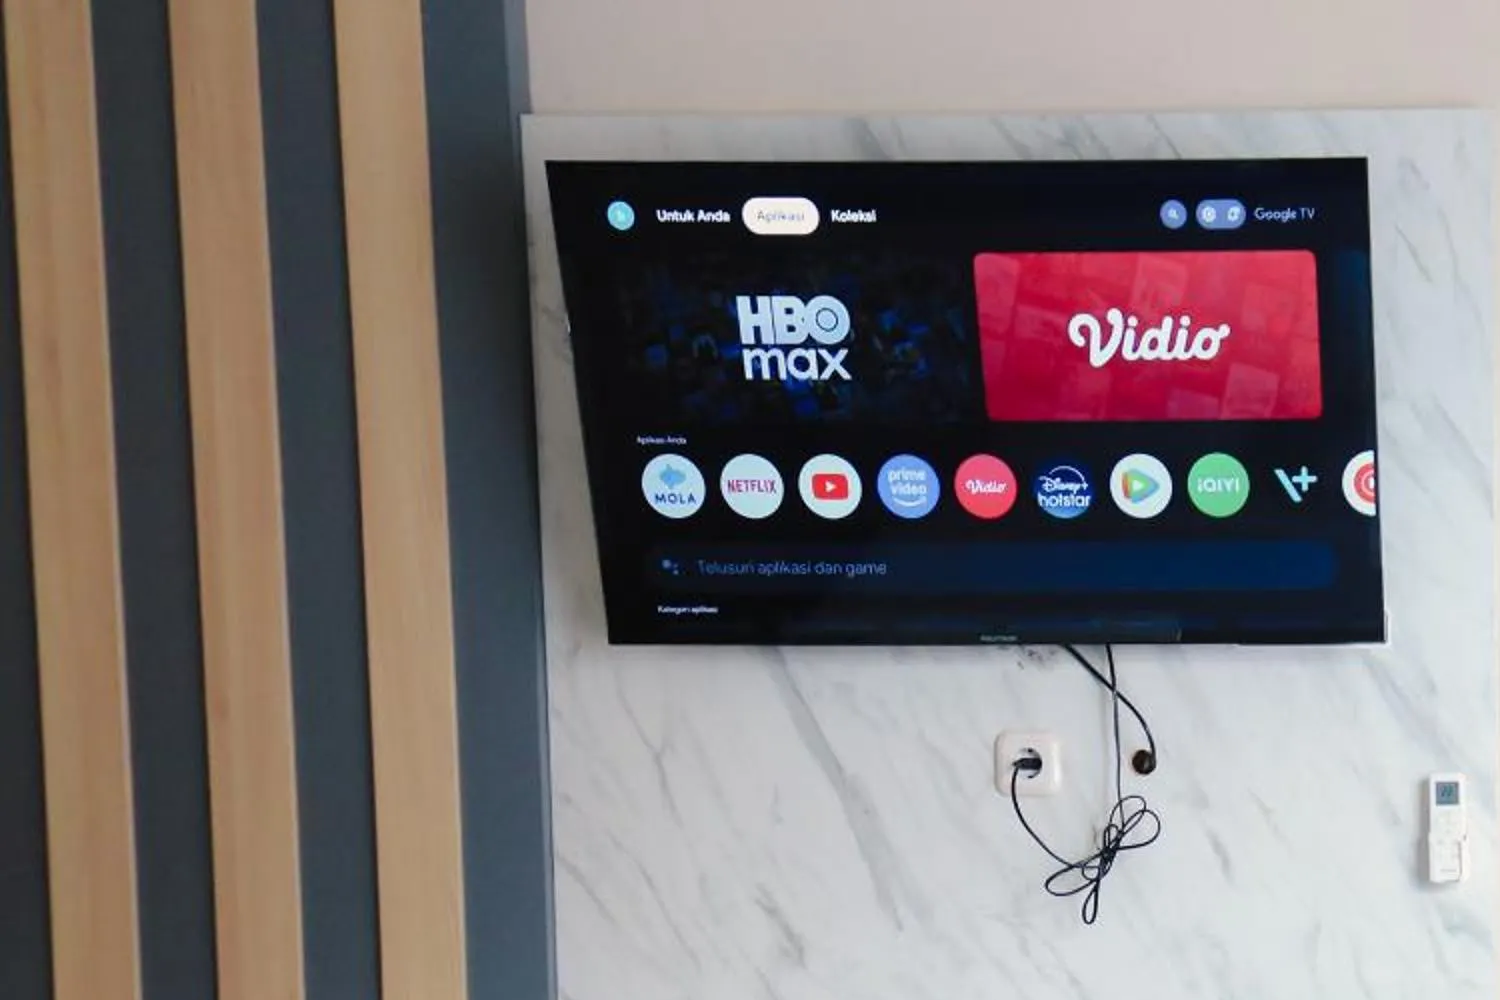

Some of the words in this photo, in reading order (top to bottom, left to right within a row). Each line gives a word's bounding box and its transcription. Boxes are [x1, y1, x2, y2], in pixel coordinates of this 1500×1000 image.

[656, 208, 694, 222] Untuk
[697, 208, 731, 222] Anda
[756, 209, 805, 224] Aplikasi
[831, 209, 877, 222] Koleksi
[1254, 206, 1298, 221] Google
[1300, 207, 1316, 219] TV
[736, 295, 851, 345] HBO
[1068, 307, 1230, 367] Vidio
[742, 347, 852, 380] max
[887, 467, 927, 484] prime
[726, 479, 778, 494] NETFLIX
[889, 480, 927, 496] video
[964, 478, 1007, 495] Vidio
[654, 492, 698, 505] MOLA
[1037, 492, 1091, 508] hotstar
[697, 560, 755, 575] Telusuri
[757, 560, 812, 577] aplikasi
[815, 560, 843, 575] dan
[845, 564, 888, 578] game
